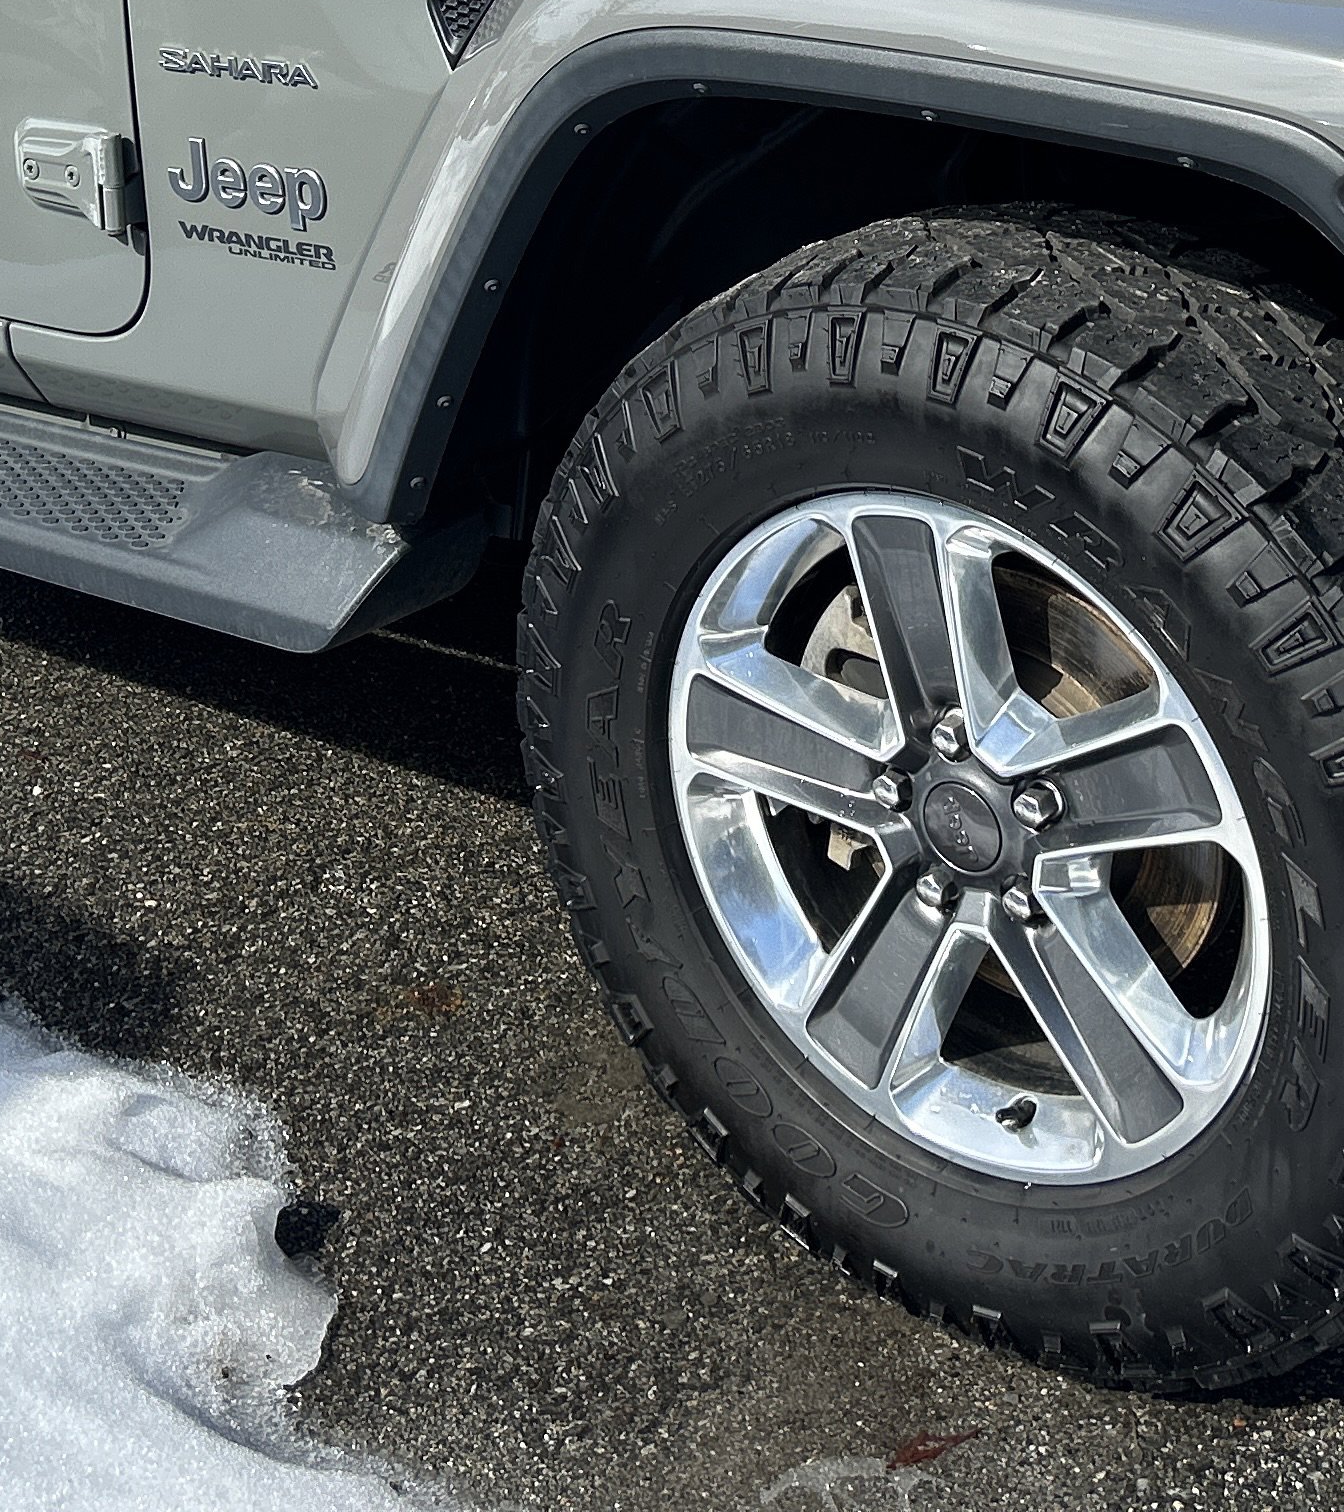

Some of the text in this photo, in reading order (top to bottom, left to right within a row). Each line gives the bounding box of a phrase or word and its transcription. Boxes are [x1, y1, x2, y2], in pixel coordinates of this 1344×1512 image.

[158, 46, 318, 90] SAHARA
[167, 137, 328, 232] Jeep
[177, 220, 336, 262] WRANGLER
[227, 245, 337, 271] UNLIMITED
